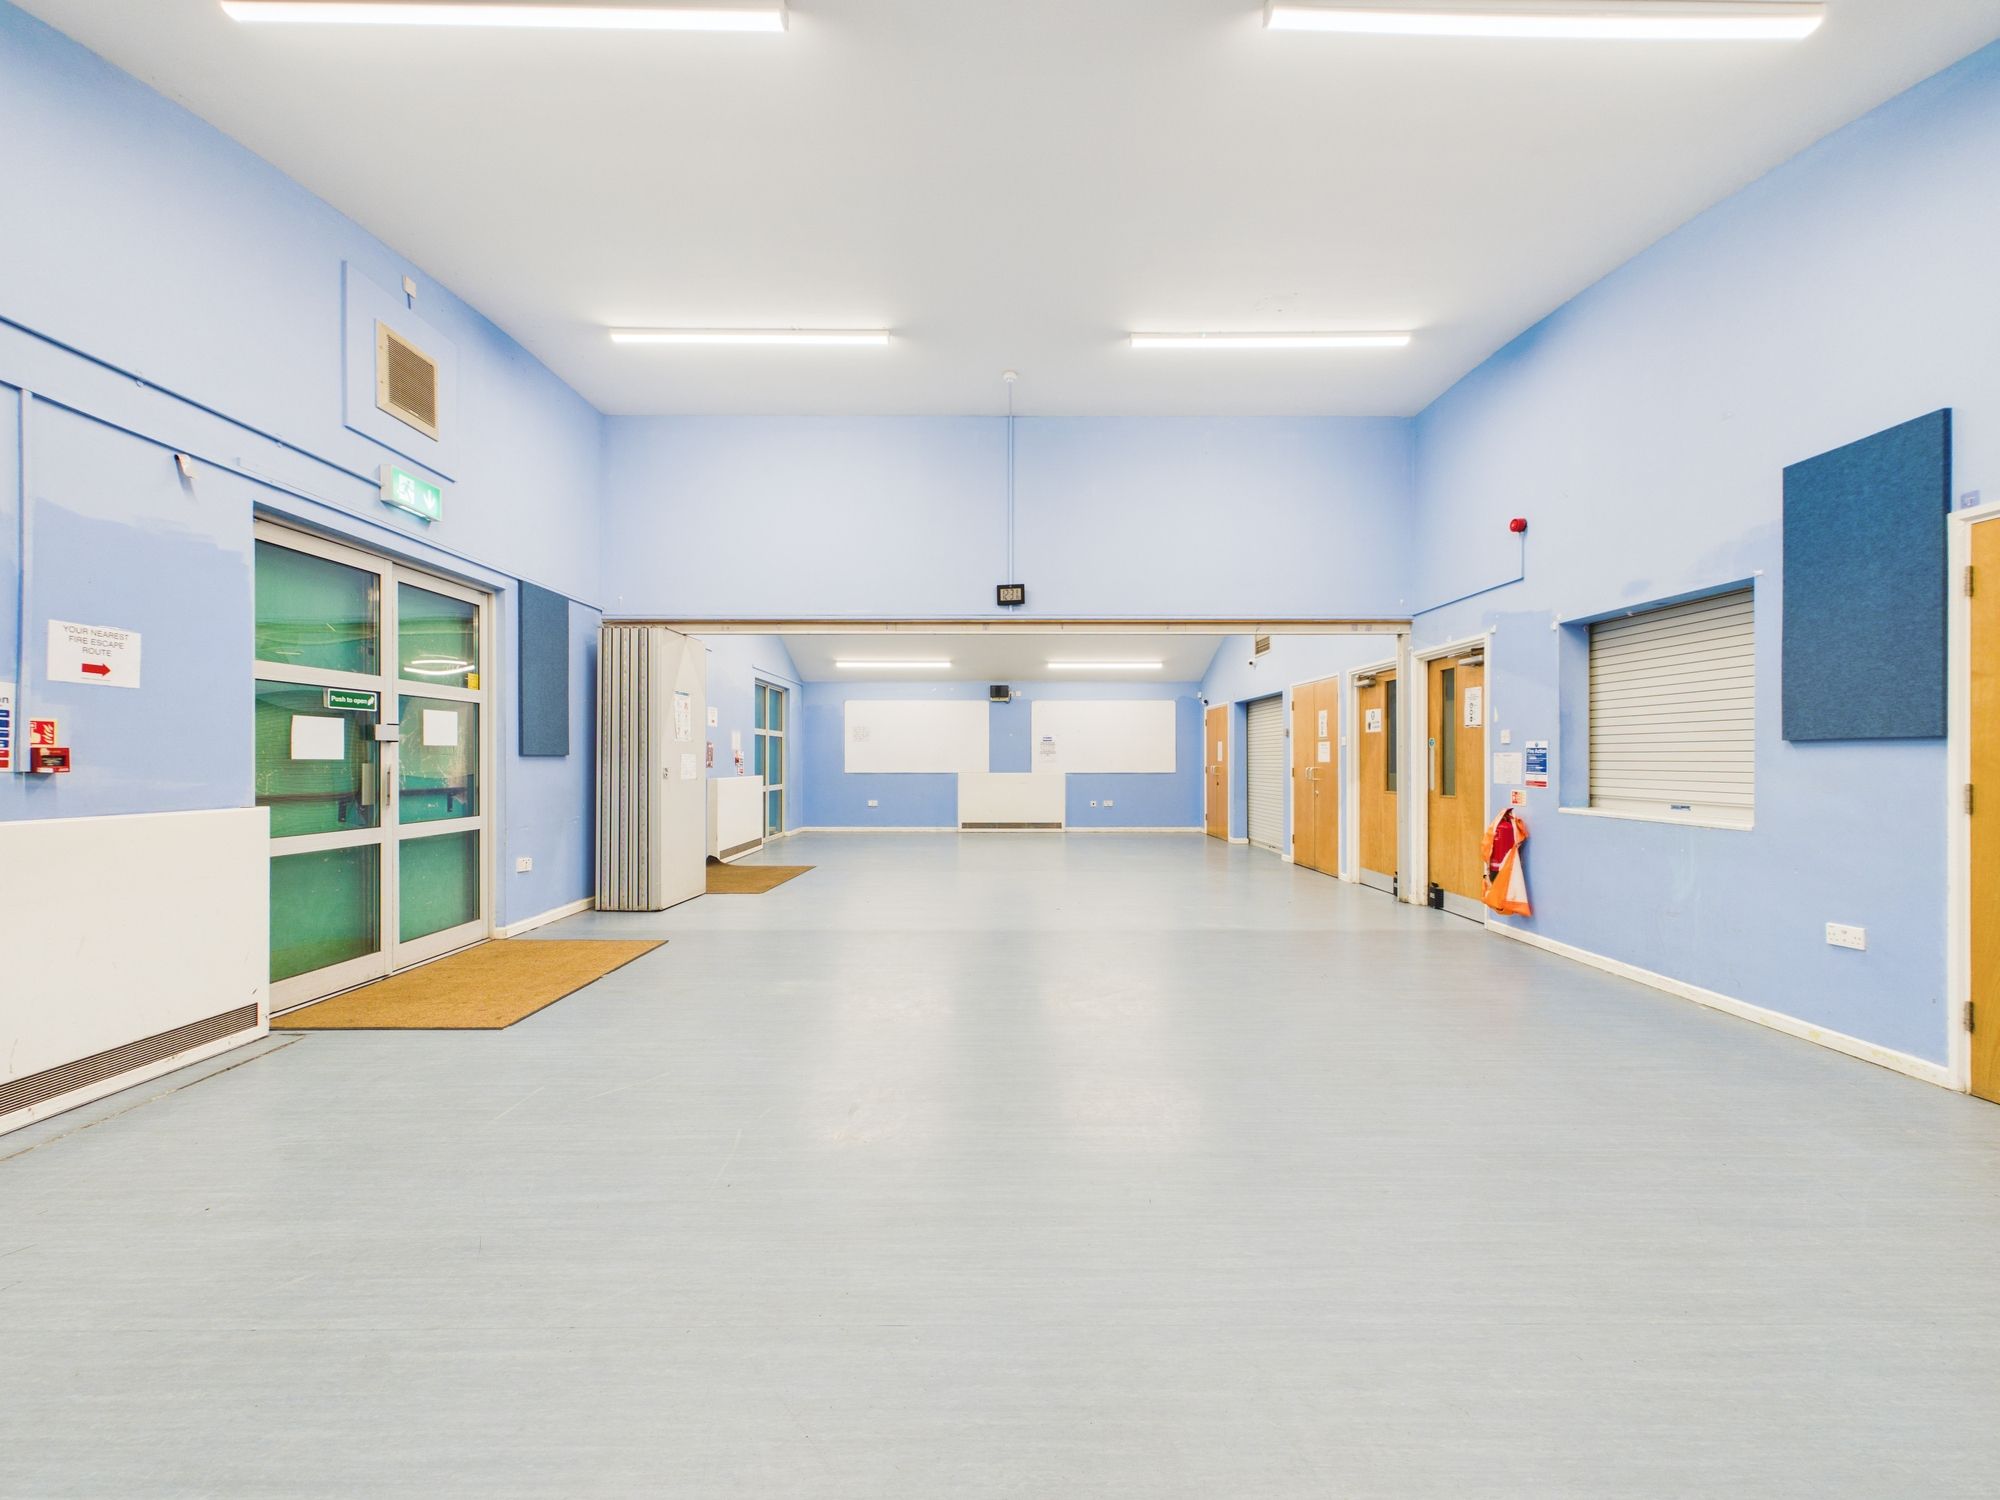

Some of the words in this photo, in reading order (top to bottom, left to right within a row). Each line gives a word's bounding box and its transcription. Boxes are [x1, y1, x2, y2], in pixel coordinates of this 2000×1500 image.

[63, 625, 88, 634] YOUR
[91, 630, 129, 640] NEAREST
[68, 636, 88, 644] FIRE
[90, 638, 125, 650] ESCAPE
[82, 647, 112, 656] ROUTE
